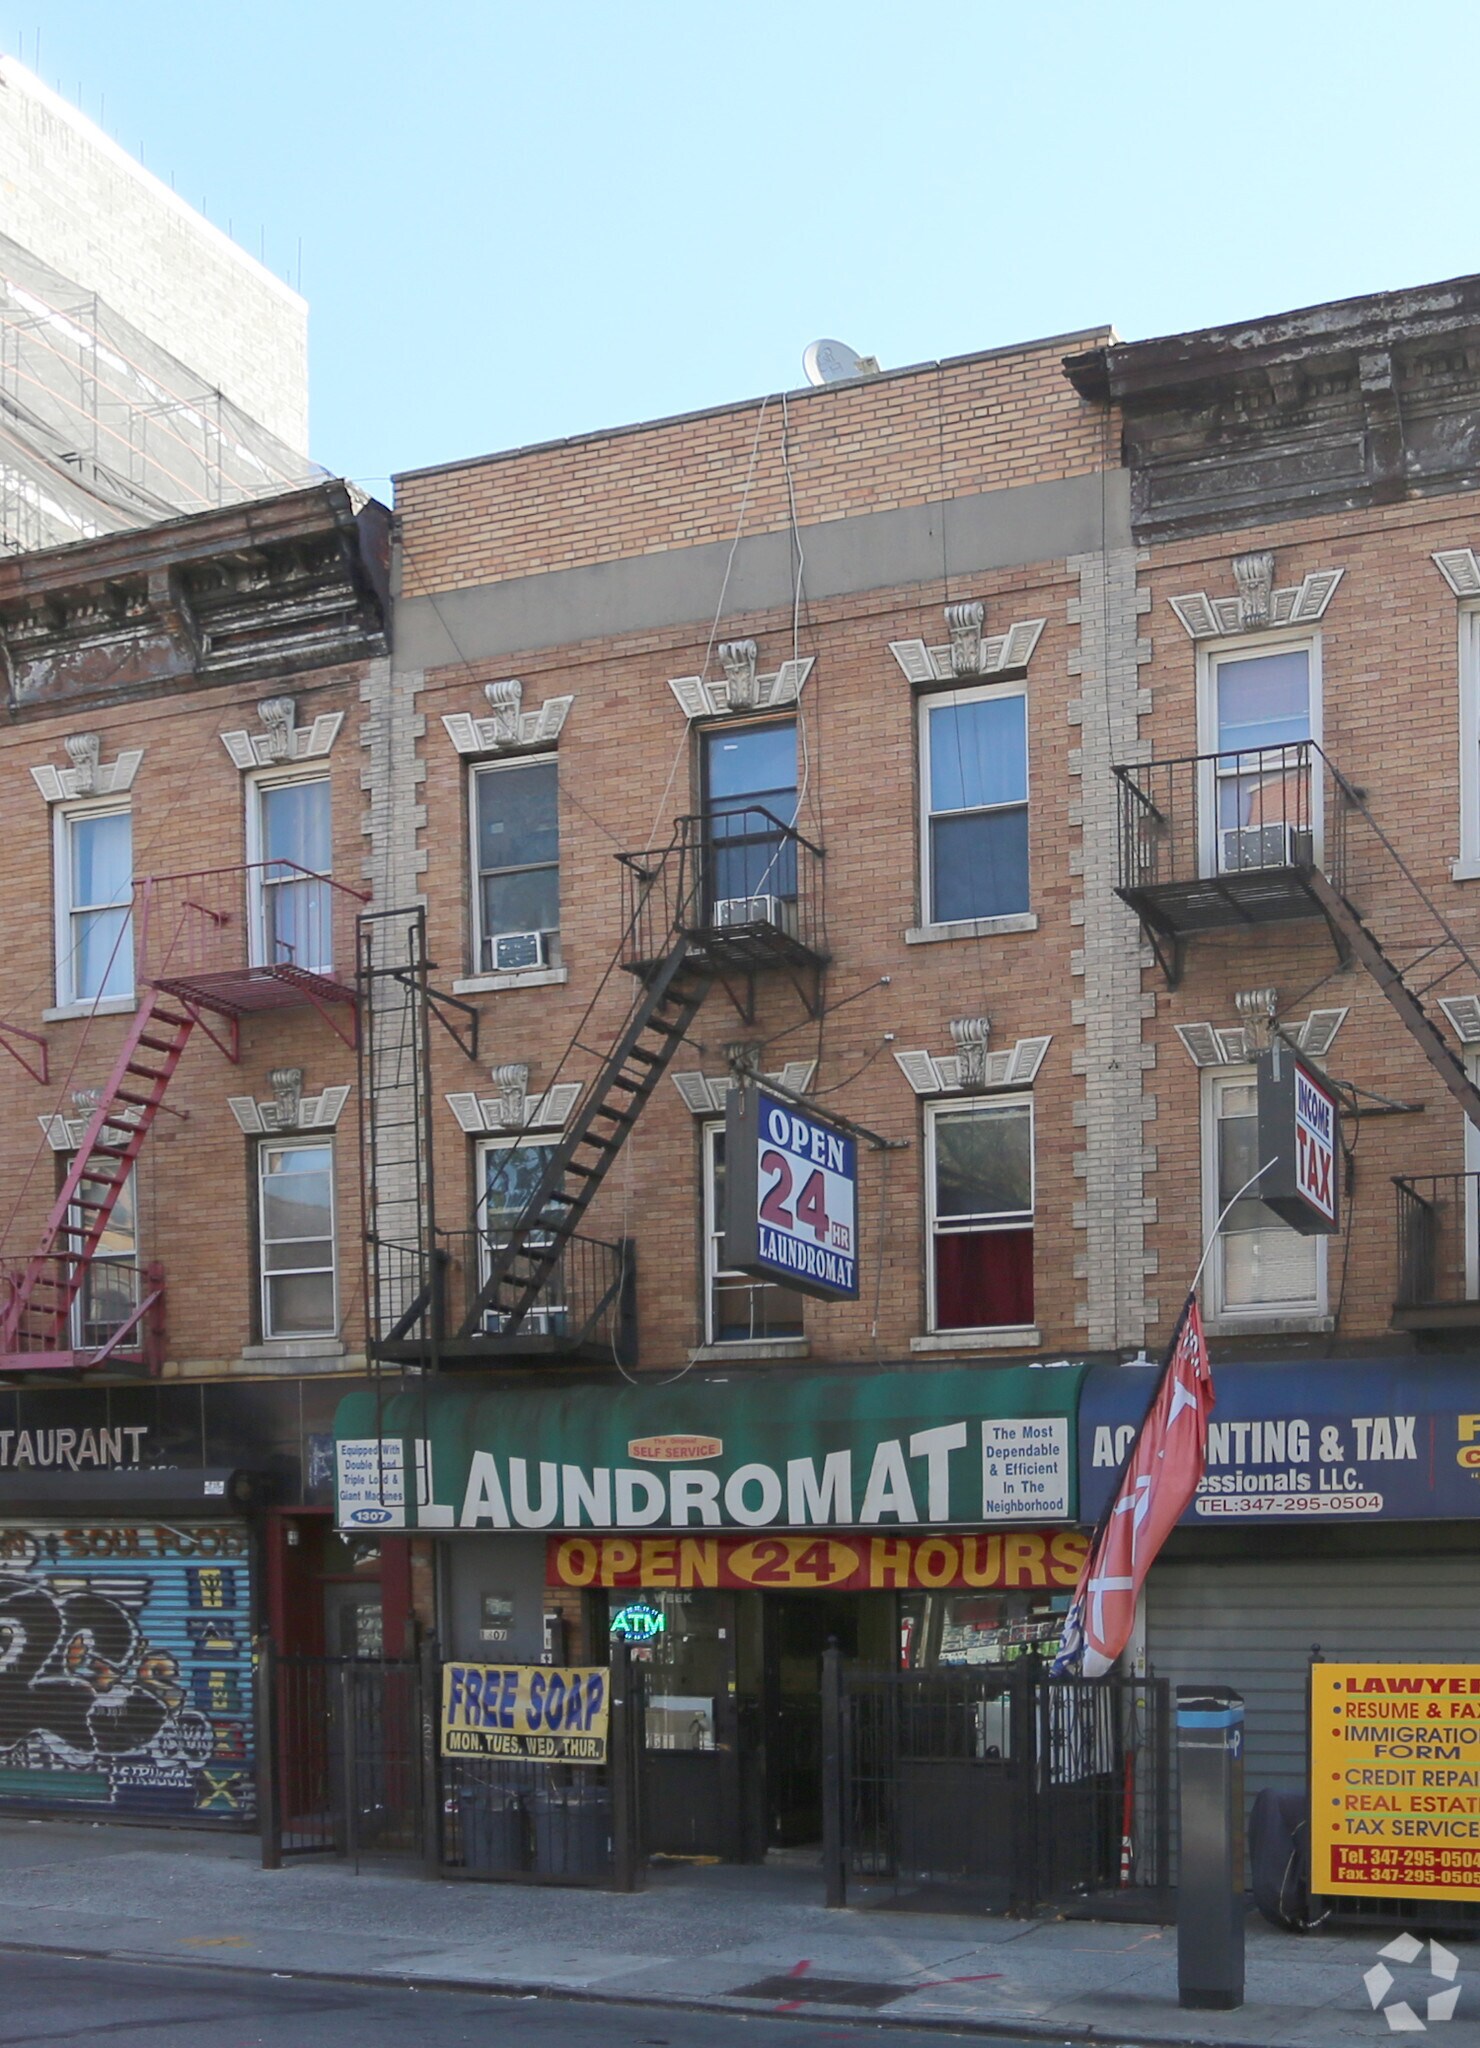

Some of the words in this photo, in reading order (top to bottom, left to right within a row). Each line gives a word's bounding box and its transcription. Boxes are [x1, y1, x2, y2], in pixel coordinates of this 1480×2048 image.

[1299, 1076, 1330, 1139] INCOME
[768, 1109, 845, 1173] OPEN
[1297, 1124, 1331, 1210] TAX
[759, 1149, 829, 1243] 24
[832, 1223, 849, 1249] HR
[759, 1227, 853, 1288] LAUNDROMAT
[993, 1427, 1016, 1439] The
[1023, 1426, 1053, 1438] Most
[1092, 1419, 1310, 1467] ACNTING
[1319, 1425, 1344, 1463] &
[1352, 1416, 1417, 1461] TAX
[341, 1445, 378, 1457] Equipped
[381, 1444, 400, 1454] With
[633, 1446, 660, 1457] SELF
[665, 1444, 716, 1458] SERVICE
[986, 1445, 1060, 1460] Dependable
[345, 1460, 373, 1469] Double
[989, 1464, 998, 1476] &
[1005, 1462, 1058, 1476] Efficient
[343, 1474, 364, 1486] Triple
[369, 1474, 388, 1484] Lod
[392, 1474, 398, 1484] &
[415, 1422, 967, 1528] LAUNDROMAT
[1319, 1468, 1364, 1491] LLC.
[340, 1491, 361, 1500] Giant
[1003, 1482, 1014, 1494] In
[1021, 1481, 1045, 1493] The
[986, 1498, 1063, 1514] Neighborhood
[1200, 1496, 1381, 1513] TEL:347-295-0504
[356, 1511, 386, 1520] 1307
[556, 1538, 719, 1587] OPEN
[751, 1541, 835, 1582] 24
[870, 1533, 1092, 1588] HOURS
[610, 1611, 665, 1632] ATM
[448, 1668, 519, 1729] FREE
[526, 1671, 604, 1732] SOAP
[1346, 1703, 1419, 1718] RESUME
[1426, 1703, 1442, 1718] &
[1345, 1726, 1480, 1744] IMMIGRATIO
[449, 1731, 483, 1751] MON.
[563, 1737, 600, 1757] THUR.
[1374, 1745, 1461, 1759] FORM
[1345, 1769, 1416, 1785] CREDIT
[1345, 1795, 1402, 1811] REAL
[1410, 1796, 1480, 1813] ESTAT
[1345, 1818, 1384, 1834] TAX
[1339, 1848, 1367, 1864] Tel.
[1338, 1867, 1367, 1880] Fax.
